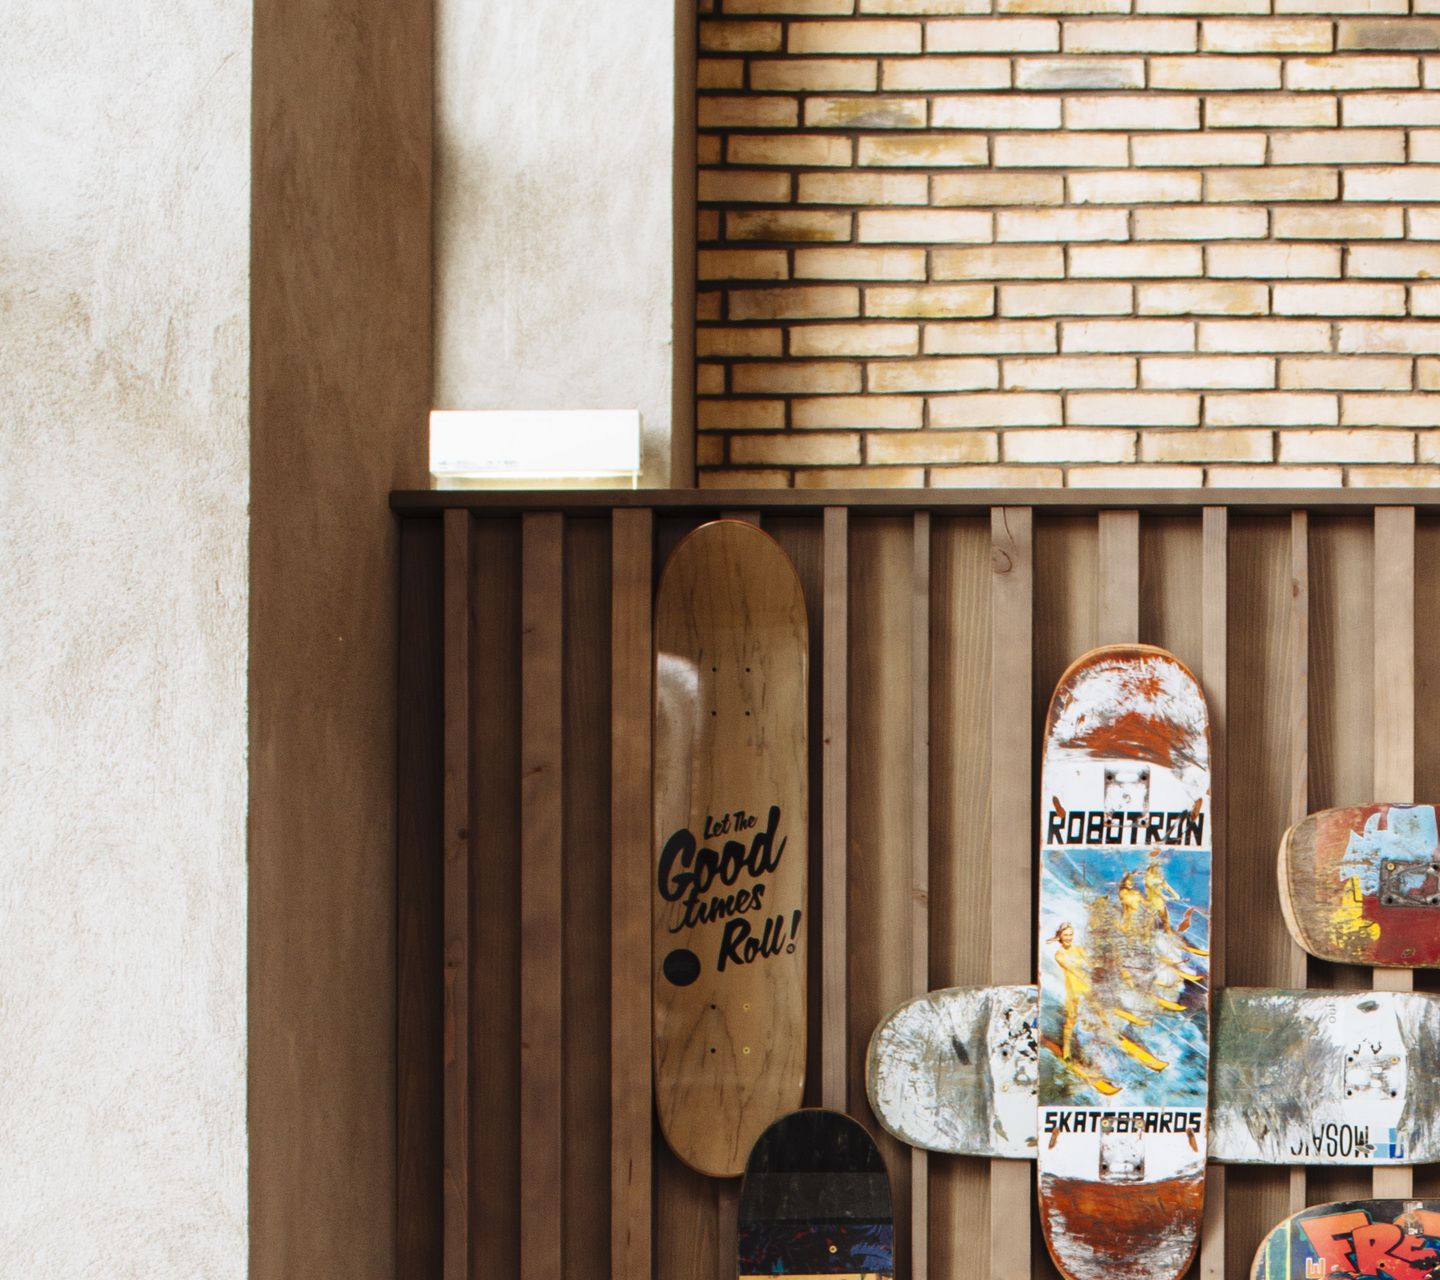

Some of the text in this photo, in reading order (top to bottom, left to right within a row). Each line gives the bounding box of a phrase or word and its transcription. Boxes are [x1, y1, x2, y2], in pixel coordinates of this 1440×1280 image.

[703, 811, 758, 840] Let The
[1047, 811, 1205, 846] ROBOTRON
[658, 805, 787, 902] Good
[669, 883, 765, 933] times
[717, 910, 802, 972] Roll!
[1044, 1111, 1202, 1133] SKATEBOARDS
